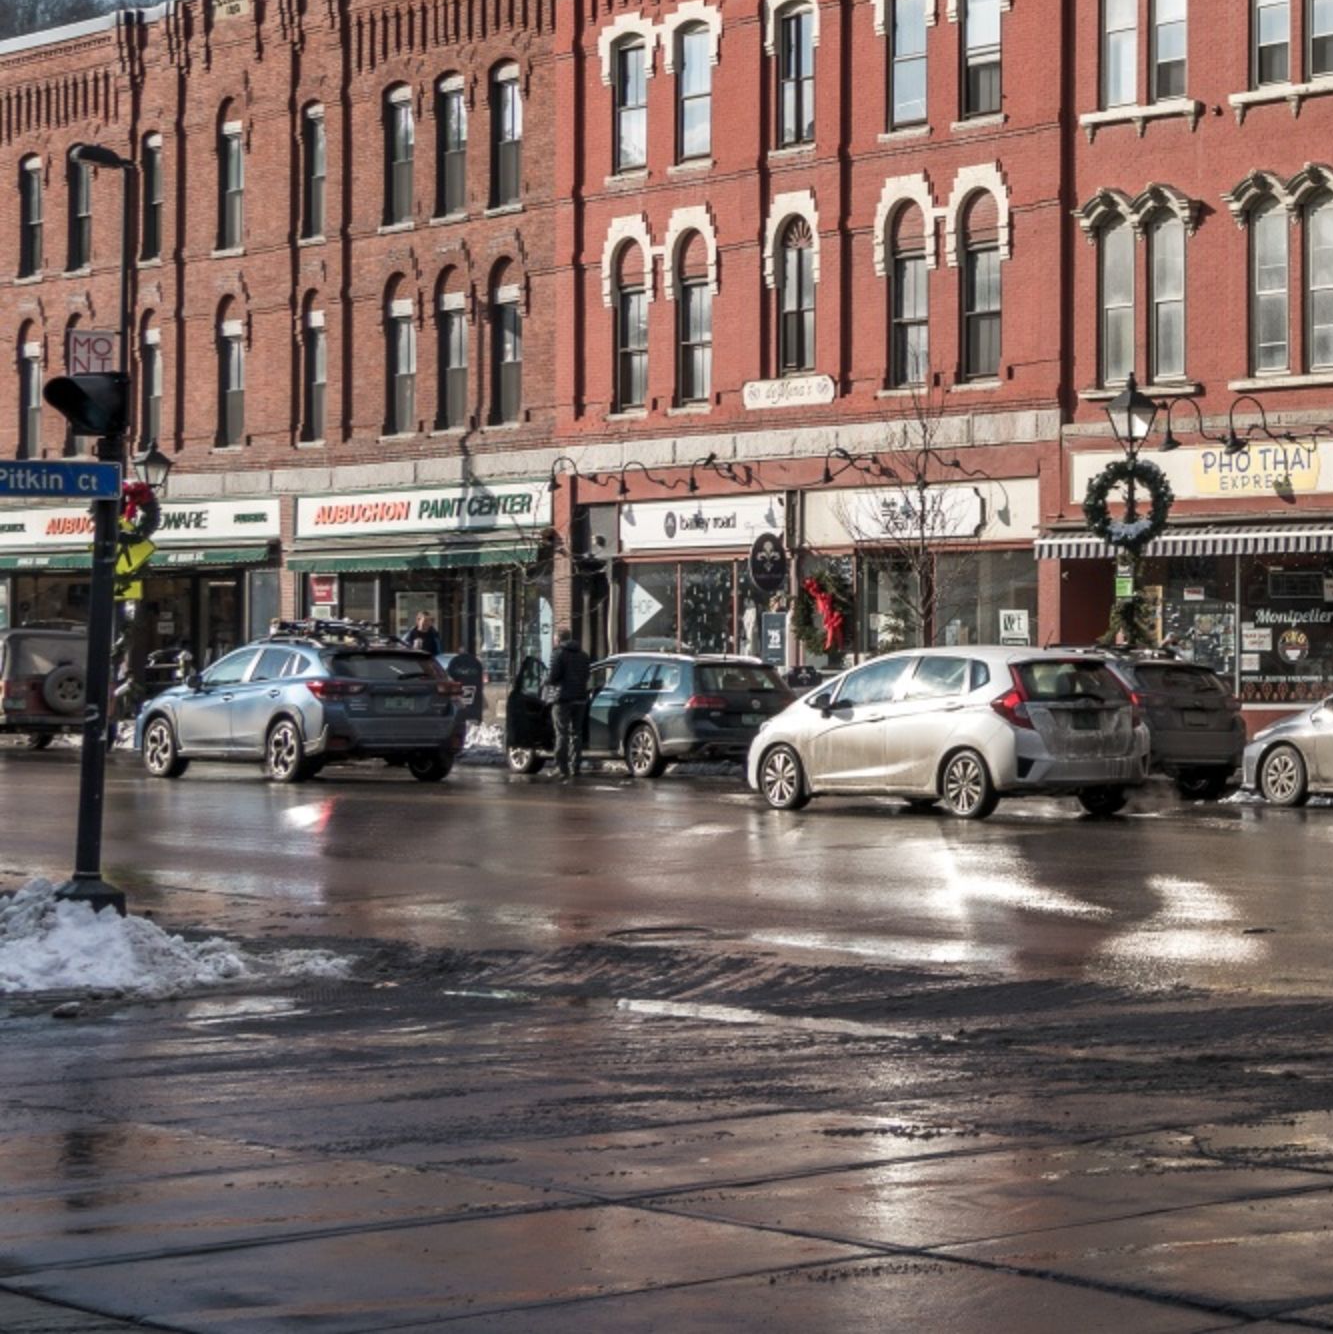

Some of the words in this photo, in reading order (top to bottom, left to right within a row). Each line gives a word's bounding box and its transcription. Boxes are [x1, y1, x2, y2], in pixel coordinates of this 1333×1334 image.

[73, 337, 112, 356] MO
[1202, 450, 1251, 475] PHO
[1258, 448, 1312, 471] THAI
[0, 467, 63, 490] Pitkin
[78, 472, 98, 491] Ct
[314, 500, 411, 525] AUBUCHON
[418, 497, 466, 520] PAINT
[467, 493, 534, 516] CENTER
